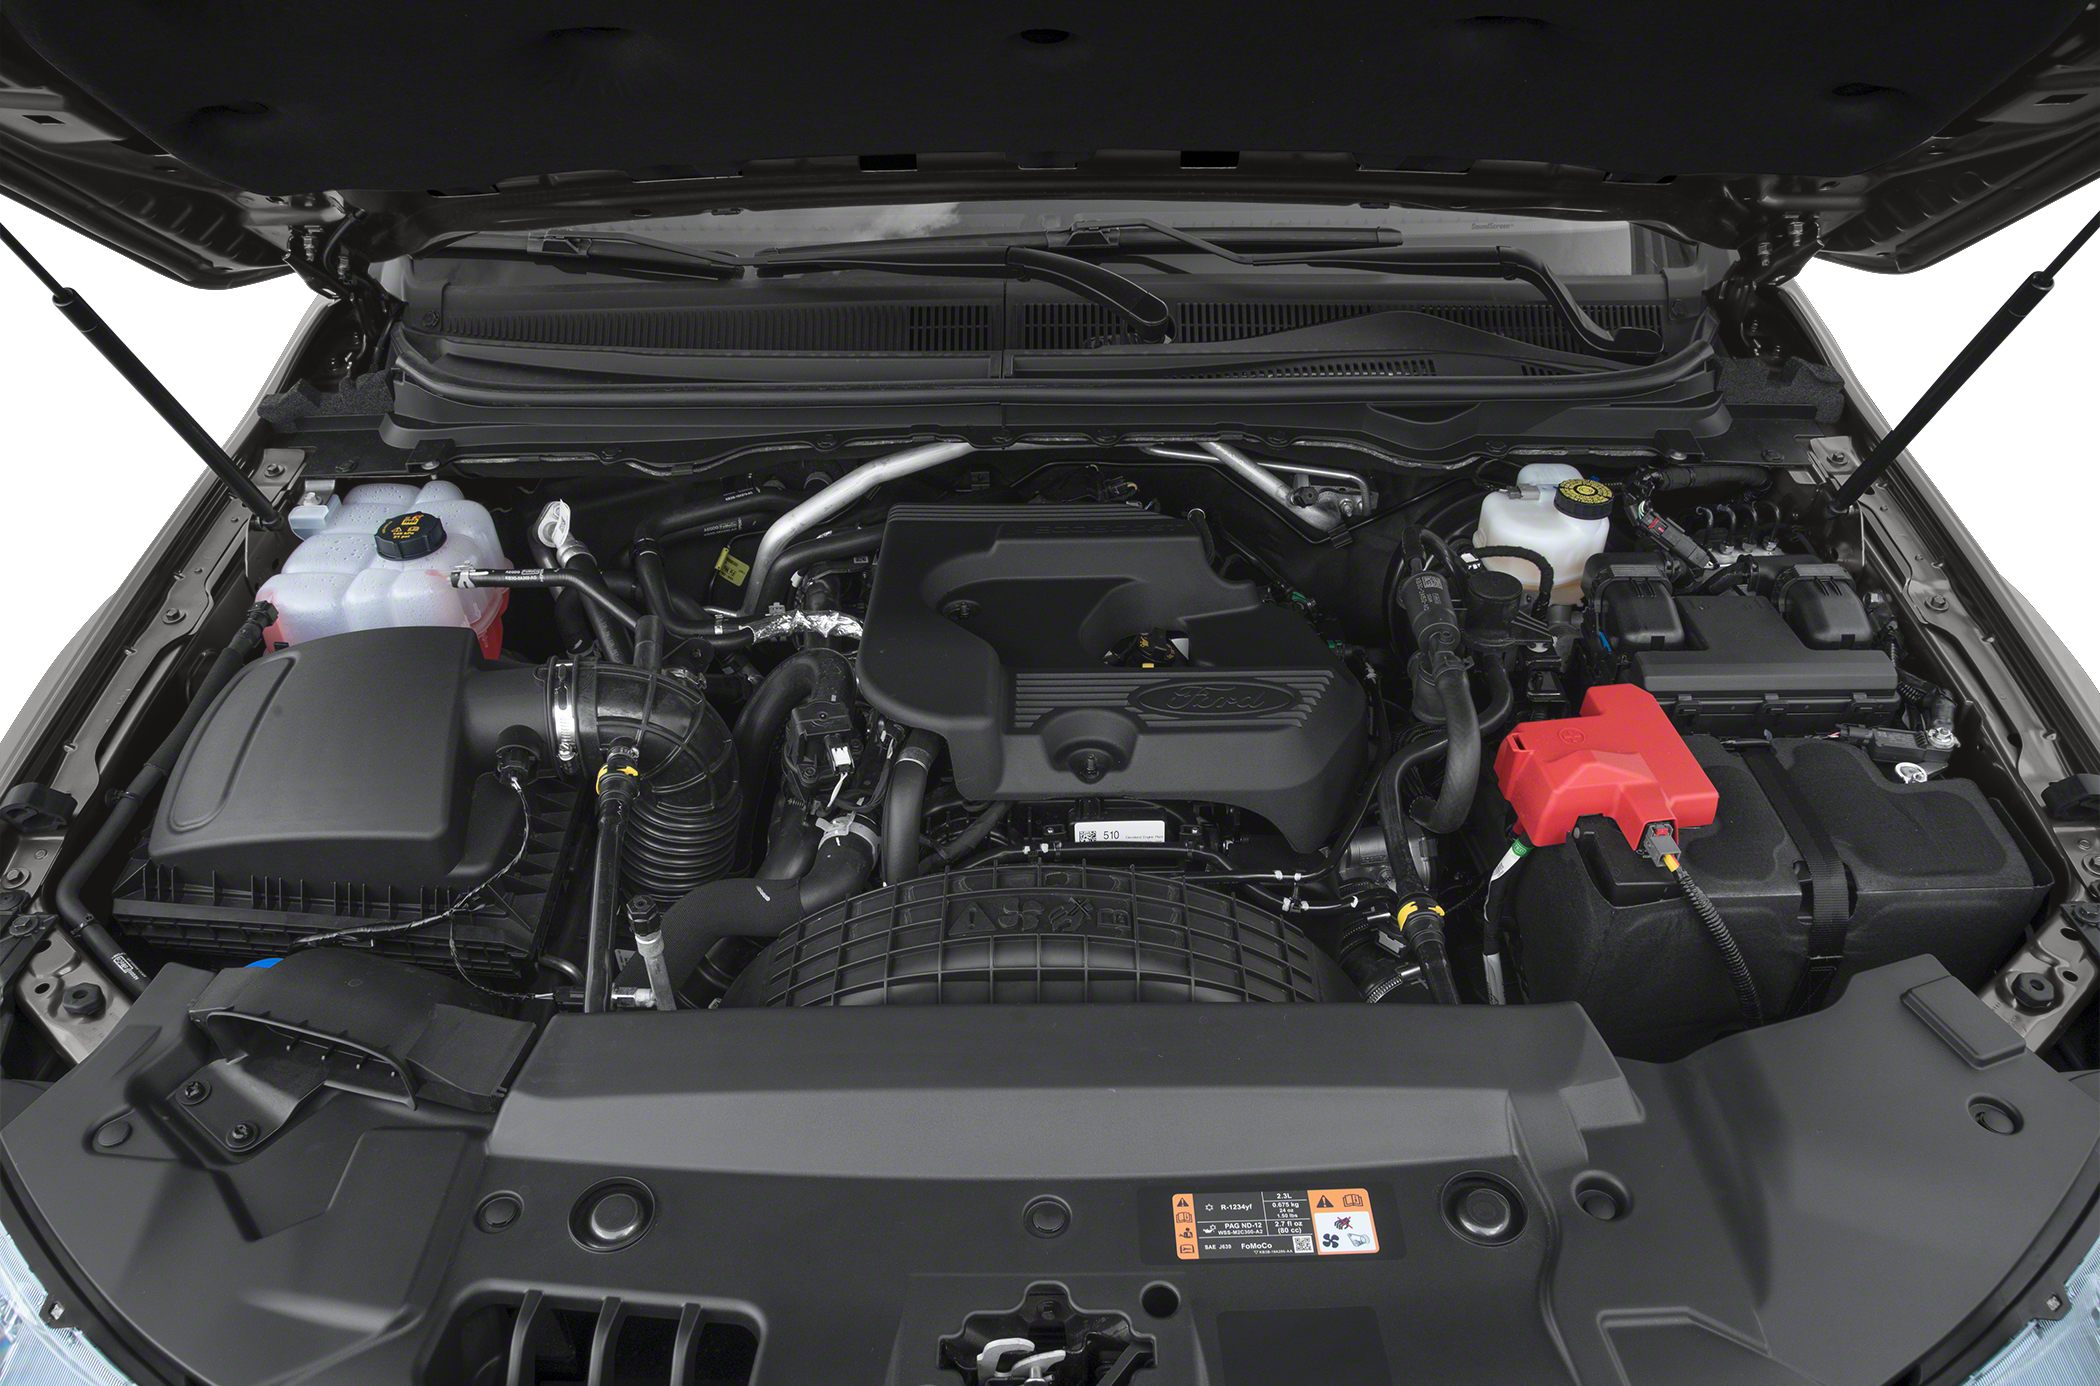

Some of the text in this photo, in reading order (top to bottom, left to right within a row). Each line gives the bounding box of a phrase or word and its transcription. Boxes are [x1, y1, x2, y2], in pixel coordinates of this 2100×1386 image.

[1166, 685, 1266, 710] Ford
[1103, 830, 1120, 840] 510
[1220, 1203, 1253, 1211] R-1234yf
[1241, 1221, 1262, 1229] ND-12
[1240, 1242, 1273, 1250] FoMoCo
